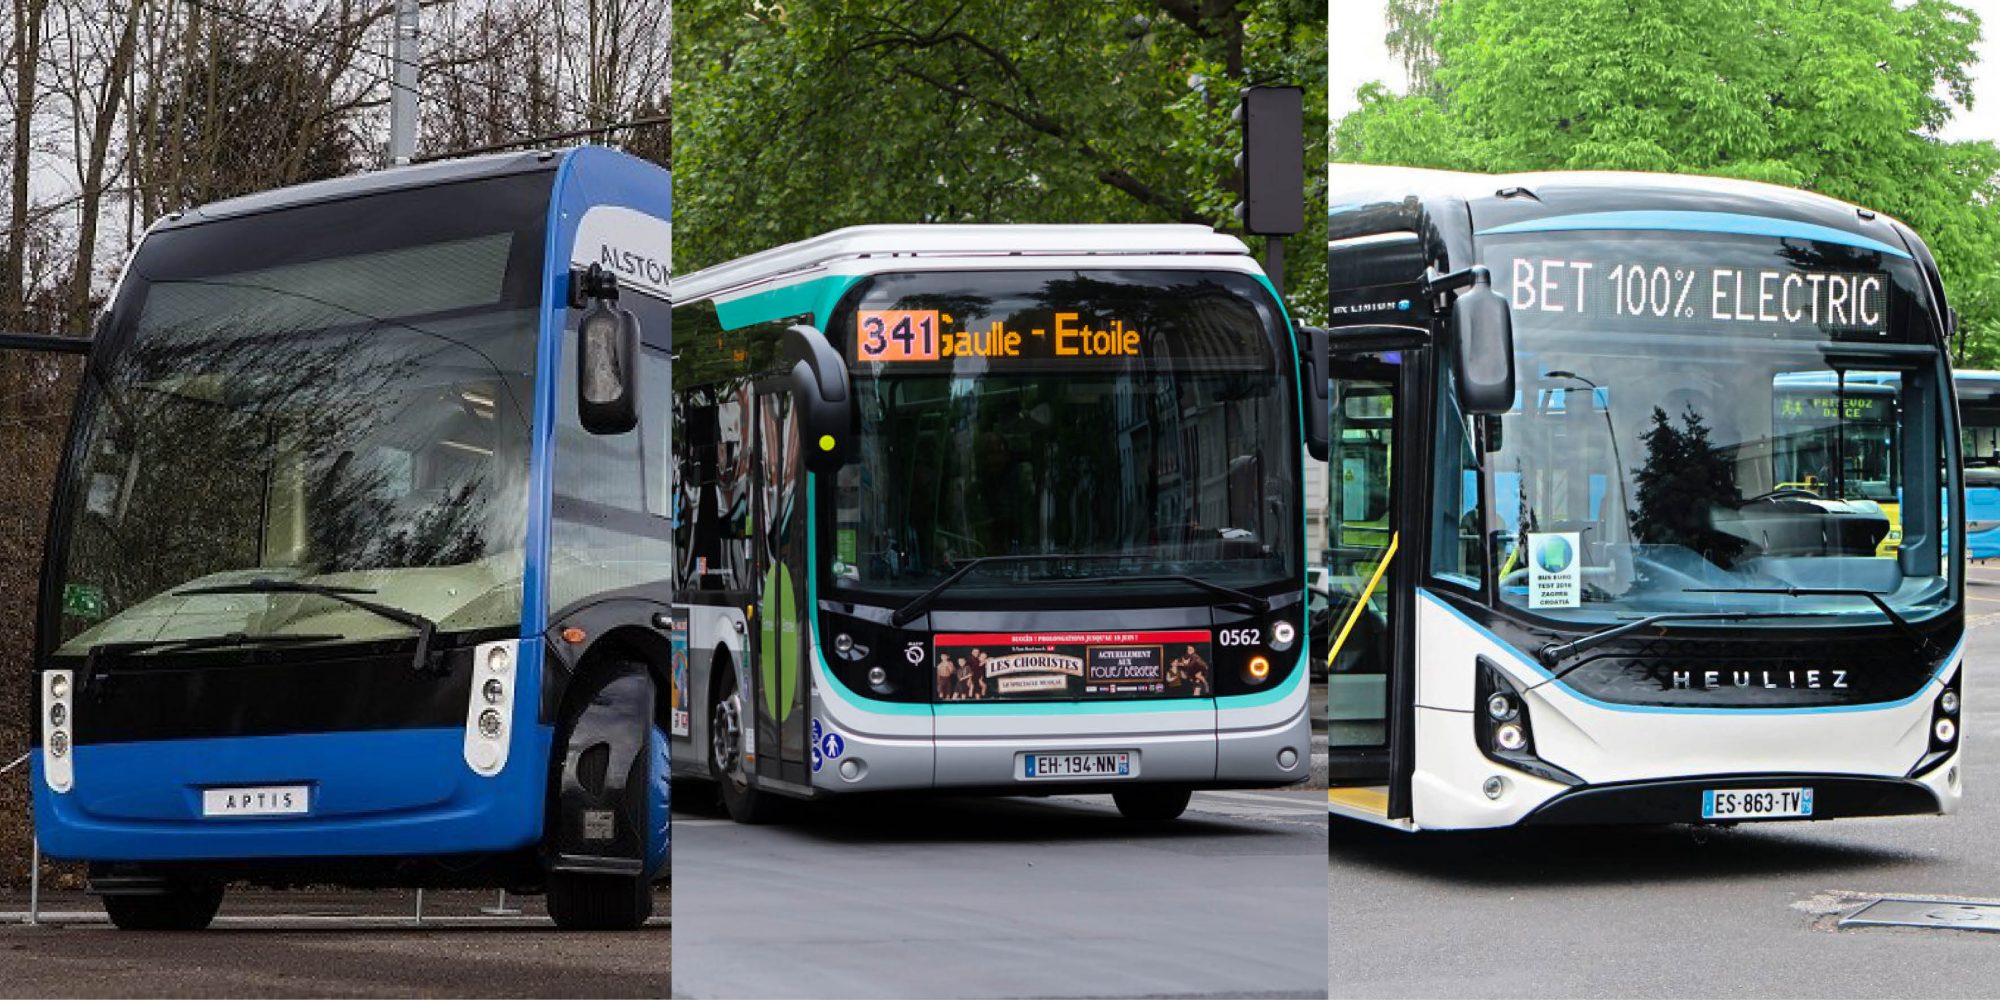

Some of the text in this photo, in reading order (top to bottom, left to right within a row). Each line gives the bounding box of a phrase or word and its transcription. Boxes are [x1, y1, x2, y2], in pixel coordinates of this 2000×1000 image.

[1512, 258, 1880, 326] BET 100% ELECTRIC
[863, 316, 933, 355] 341
[1055, 312, 1140, 356] Etoile
[1813, 399, 1873, 409] PRIEVOZ
[1823, 408, 1862, 418] DJCE
[1219, 628, 1261, 646] 0562
[1098, 650, 1152, 658] ACTUELLEMENT
[990, 656, 1079, 673] LES CHORISTES
[1038, 756, 1116, 774] EH-194-NN
[226, 792, 292, 809] APTIS
[1715, 791, 1800, 814] ES-863-TV
